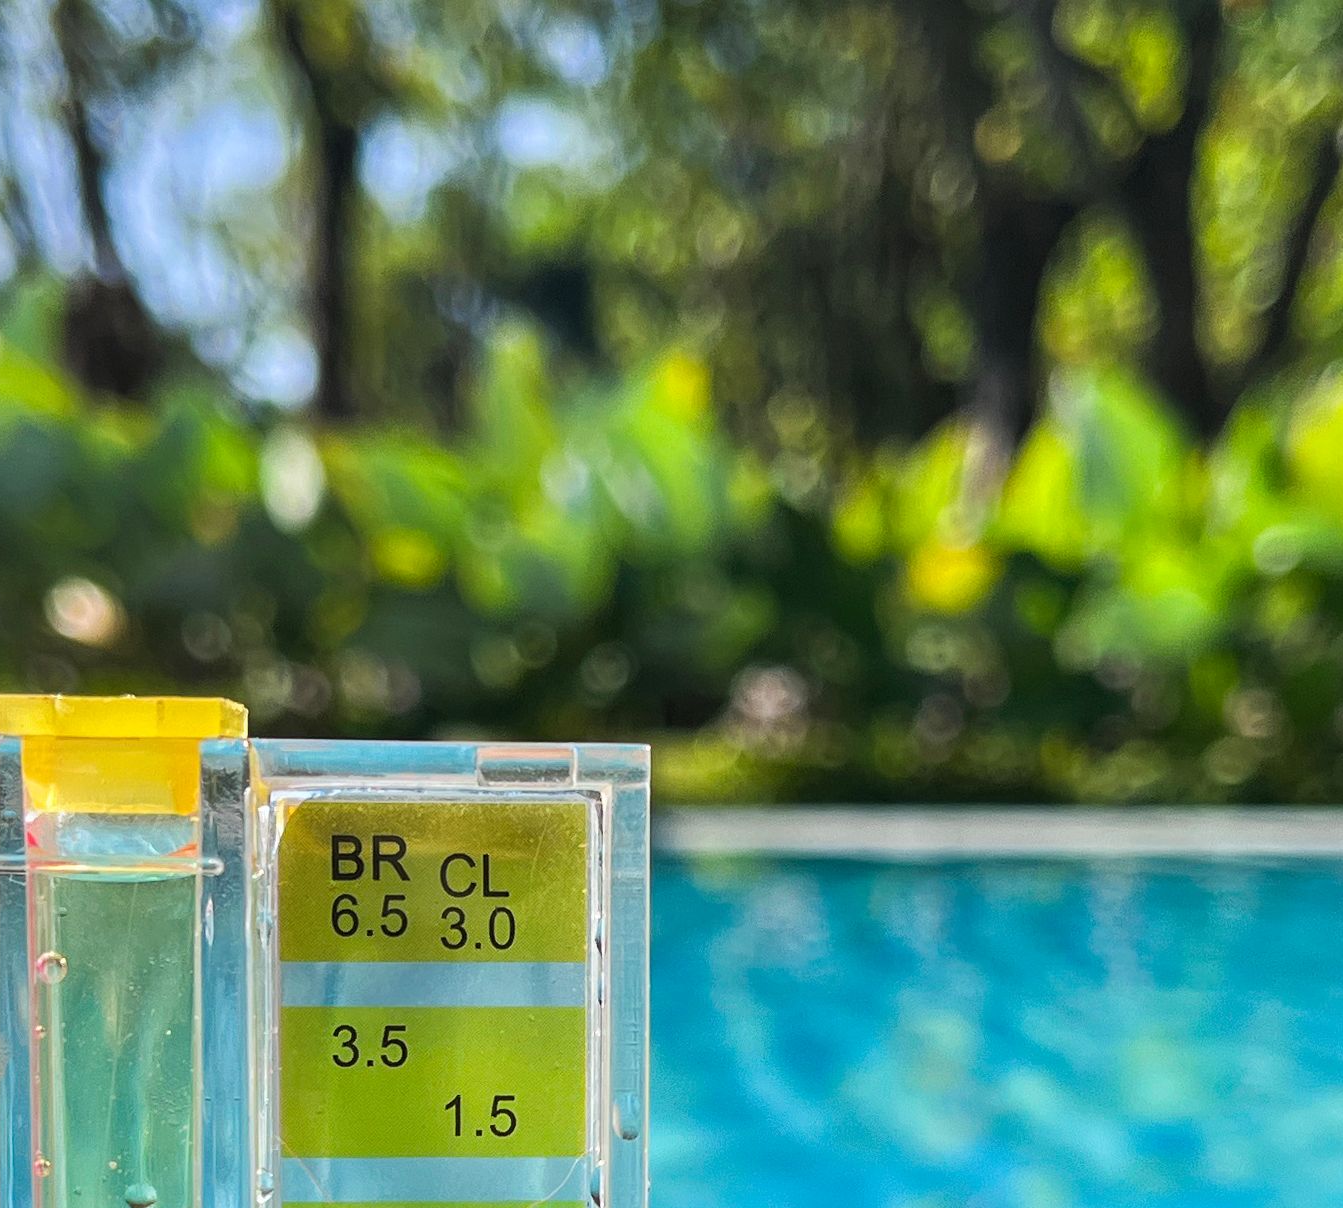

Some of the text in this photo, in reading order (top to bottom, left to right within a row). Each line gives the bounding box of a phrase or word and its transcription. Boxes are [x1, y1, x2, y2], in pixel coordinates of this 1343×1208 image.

[330, 834, 411, 882] BR
[439, 852, 510, 898] CL
[330, 893, 408, 938] 6.5
[440, 906, 516, 950] 3.0
[331, 1024, 408, 1068] 3.5
[444, 1094, 517, 1137] 1.5
